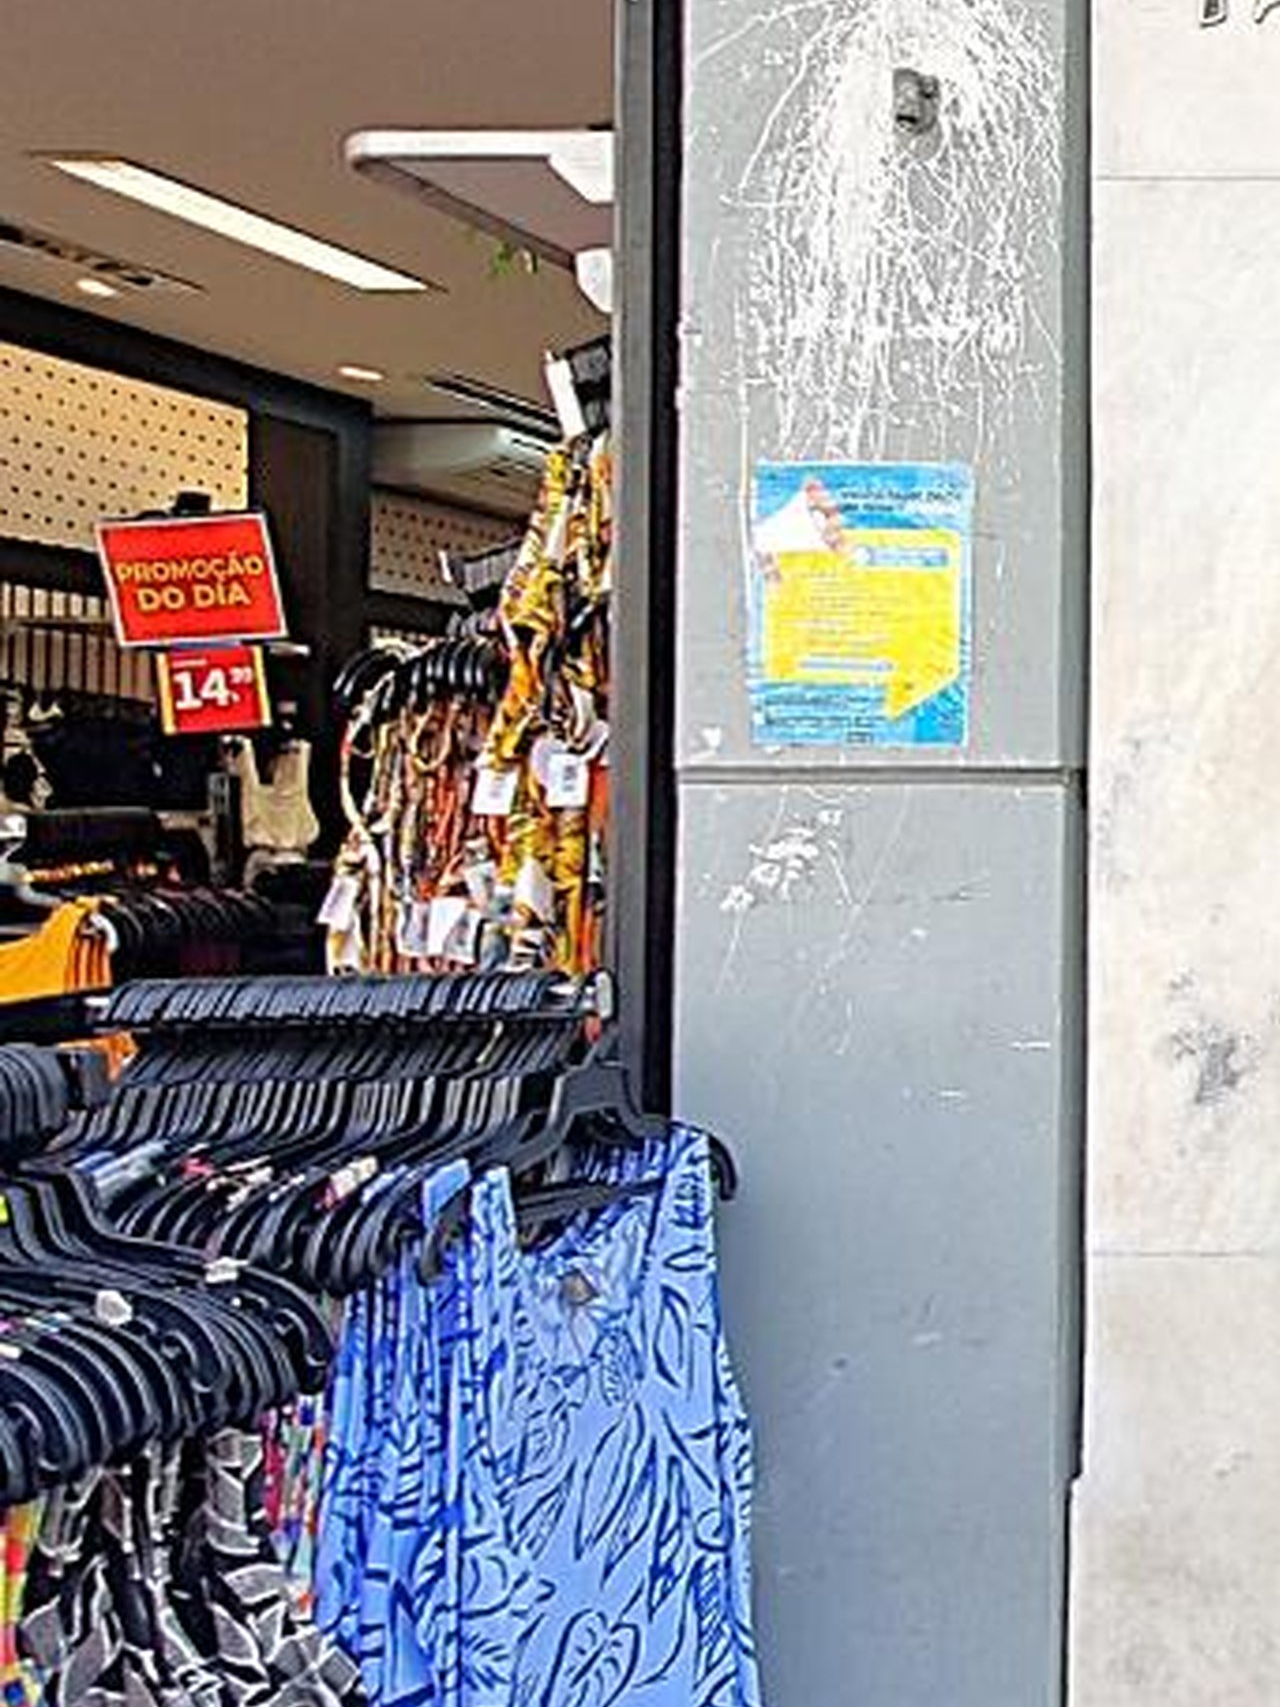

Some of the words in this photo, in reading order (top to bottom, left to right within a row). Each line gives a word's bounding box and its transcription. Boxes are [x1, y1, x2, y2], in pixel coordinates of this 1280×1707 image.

[114, 550, 264, 584] PROMOÇÃO
[137, 584, 186, 612] DO
[194, 583, 252, 608] DIA
